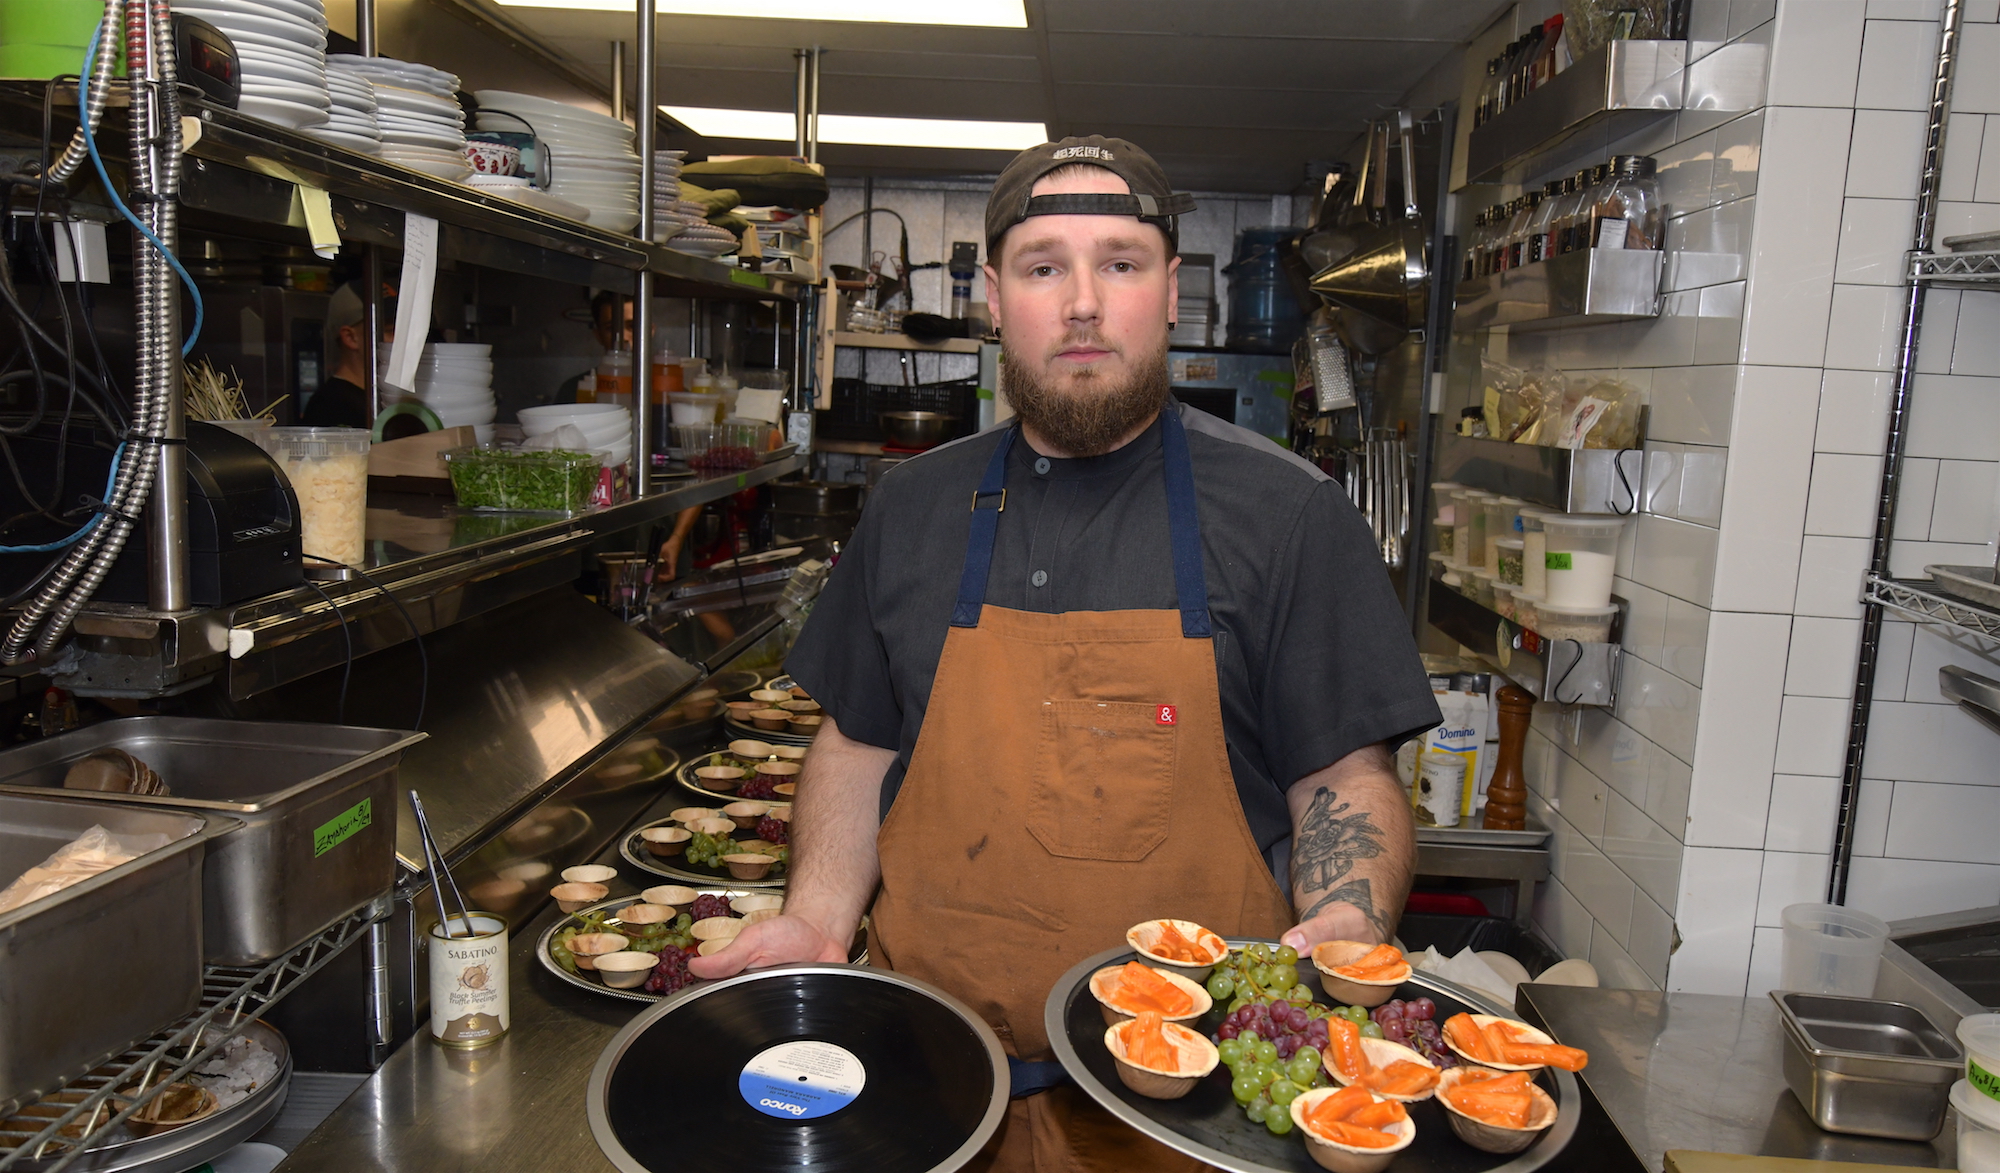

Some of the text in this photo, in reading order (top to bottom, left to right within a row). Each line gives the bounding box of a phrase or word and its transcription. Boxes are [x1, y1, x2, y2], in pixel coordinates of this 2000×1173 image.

[1161, 707, 1172, 722] &
[1438, 727, 1475, 739] Domino
[448, 945, 497, 959] SABATINO
[471, 989, 496, 998] Summer
[472, 994, 497, 1003] Peelings
[760, 1098, 807, 1115] Ronco
